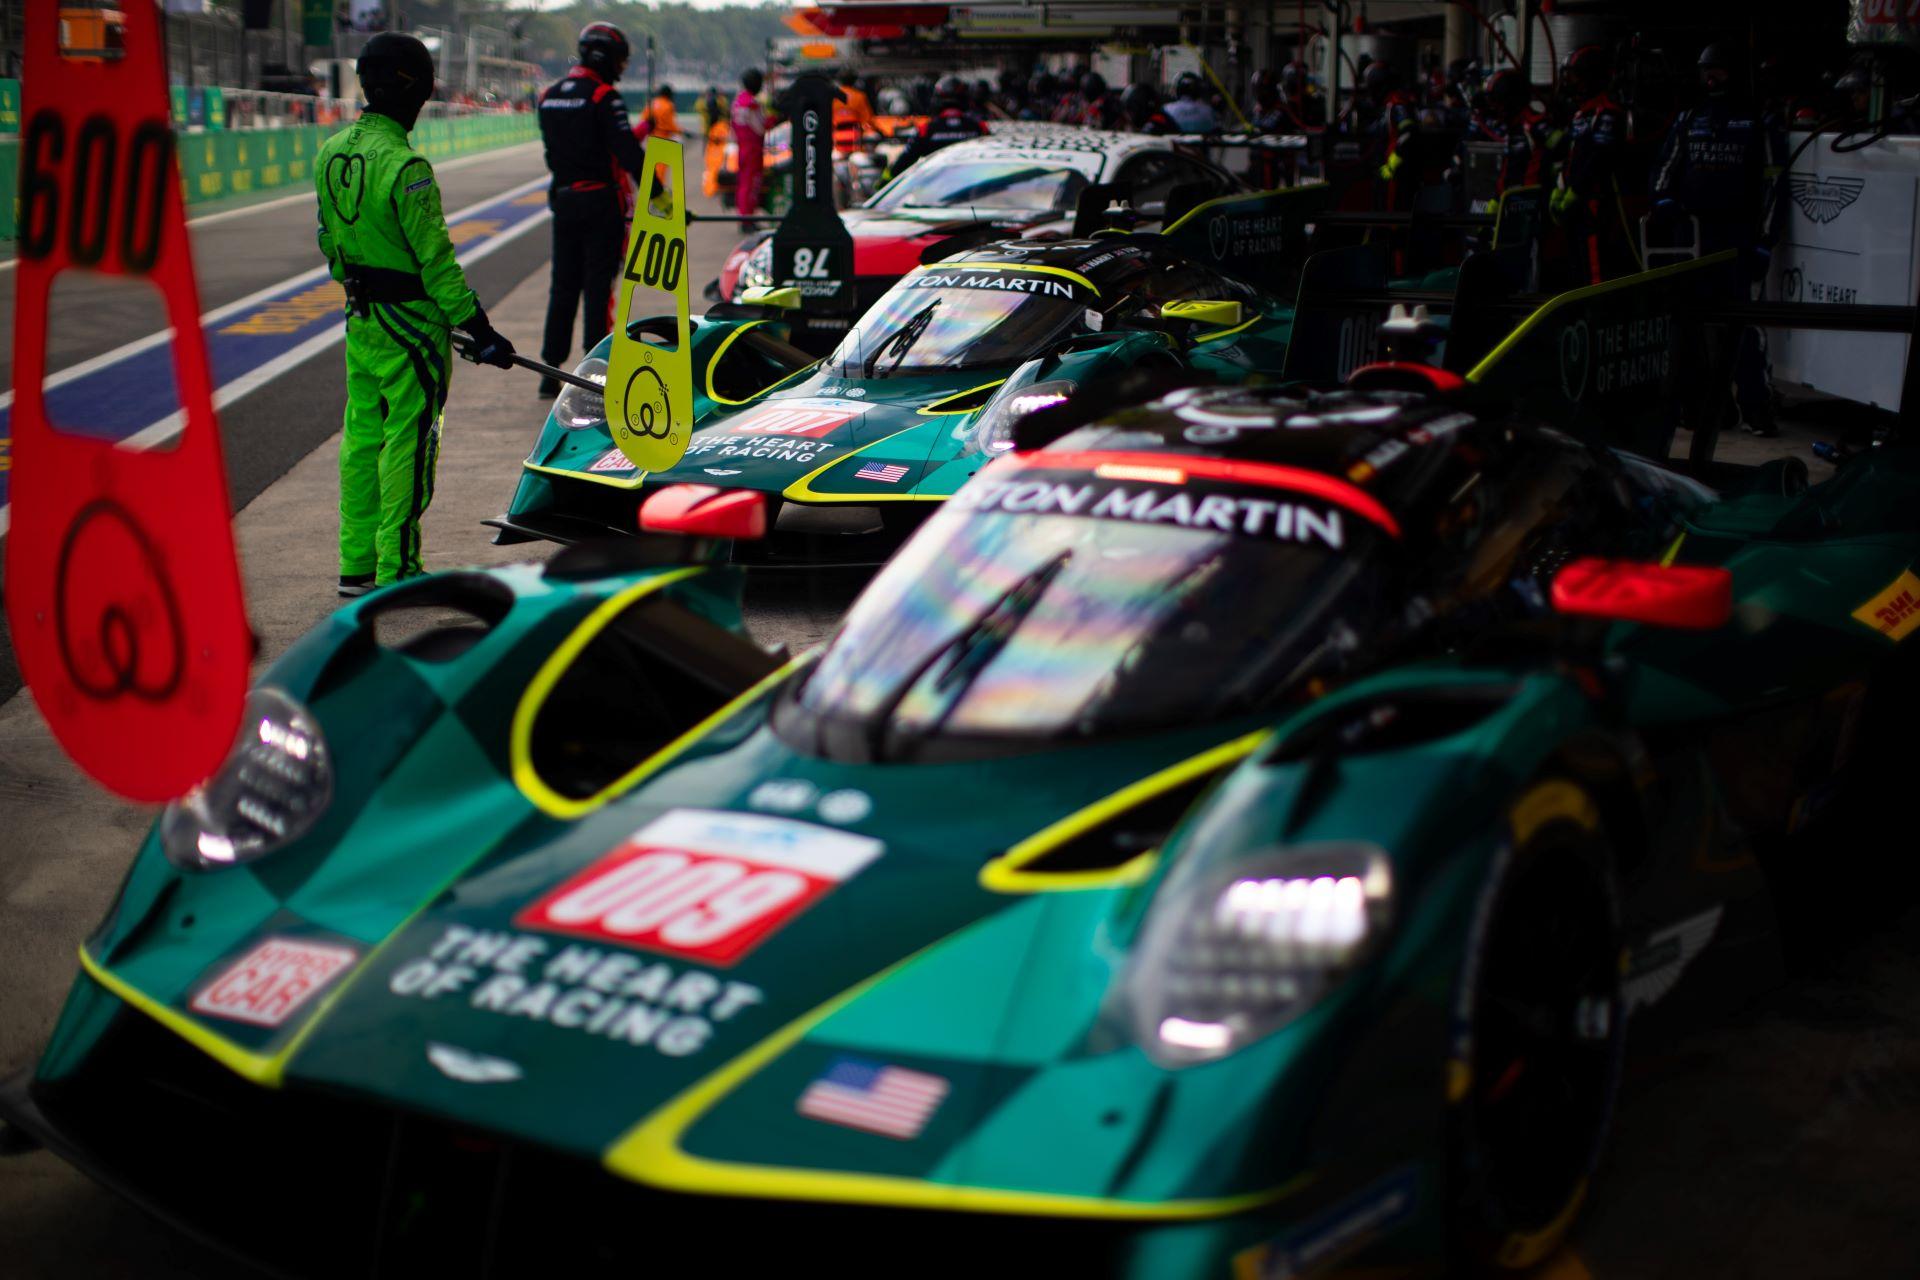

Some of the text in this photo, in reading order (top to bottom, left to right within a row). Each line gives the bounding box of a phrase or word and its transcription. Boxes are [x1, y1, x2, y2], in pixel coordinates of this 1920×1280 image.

[805, 133, 817, 199] LEXUS
[1231, 216, 1283, 236] THE HEART
[793, 247, 831, 278] 78
[1233, 235, 1282, 256] OF RACING
[906, 275, 1073, 300] TON MARTIN
[1826, 286, 1858, 304] HEART
[1597, 312, 1672, 358] THE HEART
[1597, 350, 1672, 392] OF RACING
[737, 410, 850, 433] 007
[685, 445, 816, 463] OF RACING
[694, 436, 835, 453] THE HEART
[980, 482, 1345, 550] TON MARTIN
[1875, 590, 1920, 626] DHL
[546, 850, 809, 947] 009
[248, 945, 340, 981] HYPER
[429, 925, 763, 1020] THE HEART
[209, 967, 311, 1016] CAR
[389, 959, 714, 1056] OF RACING
